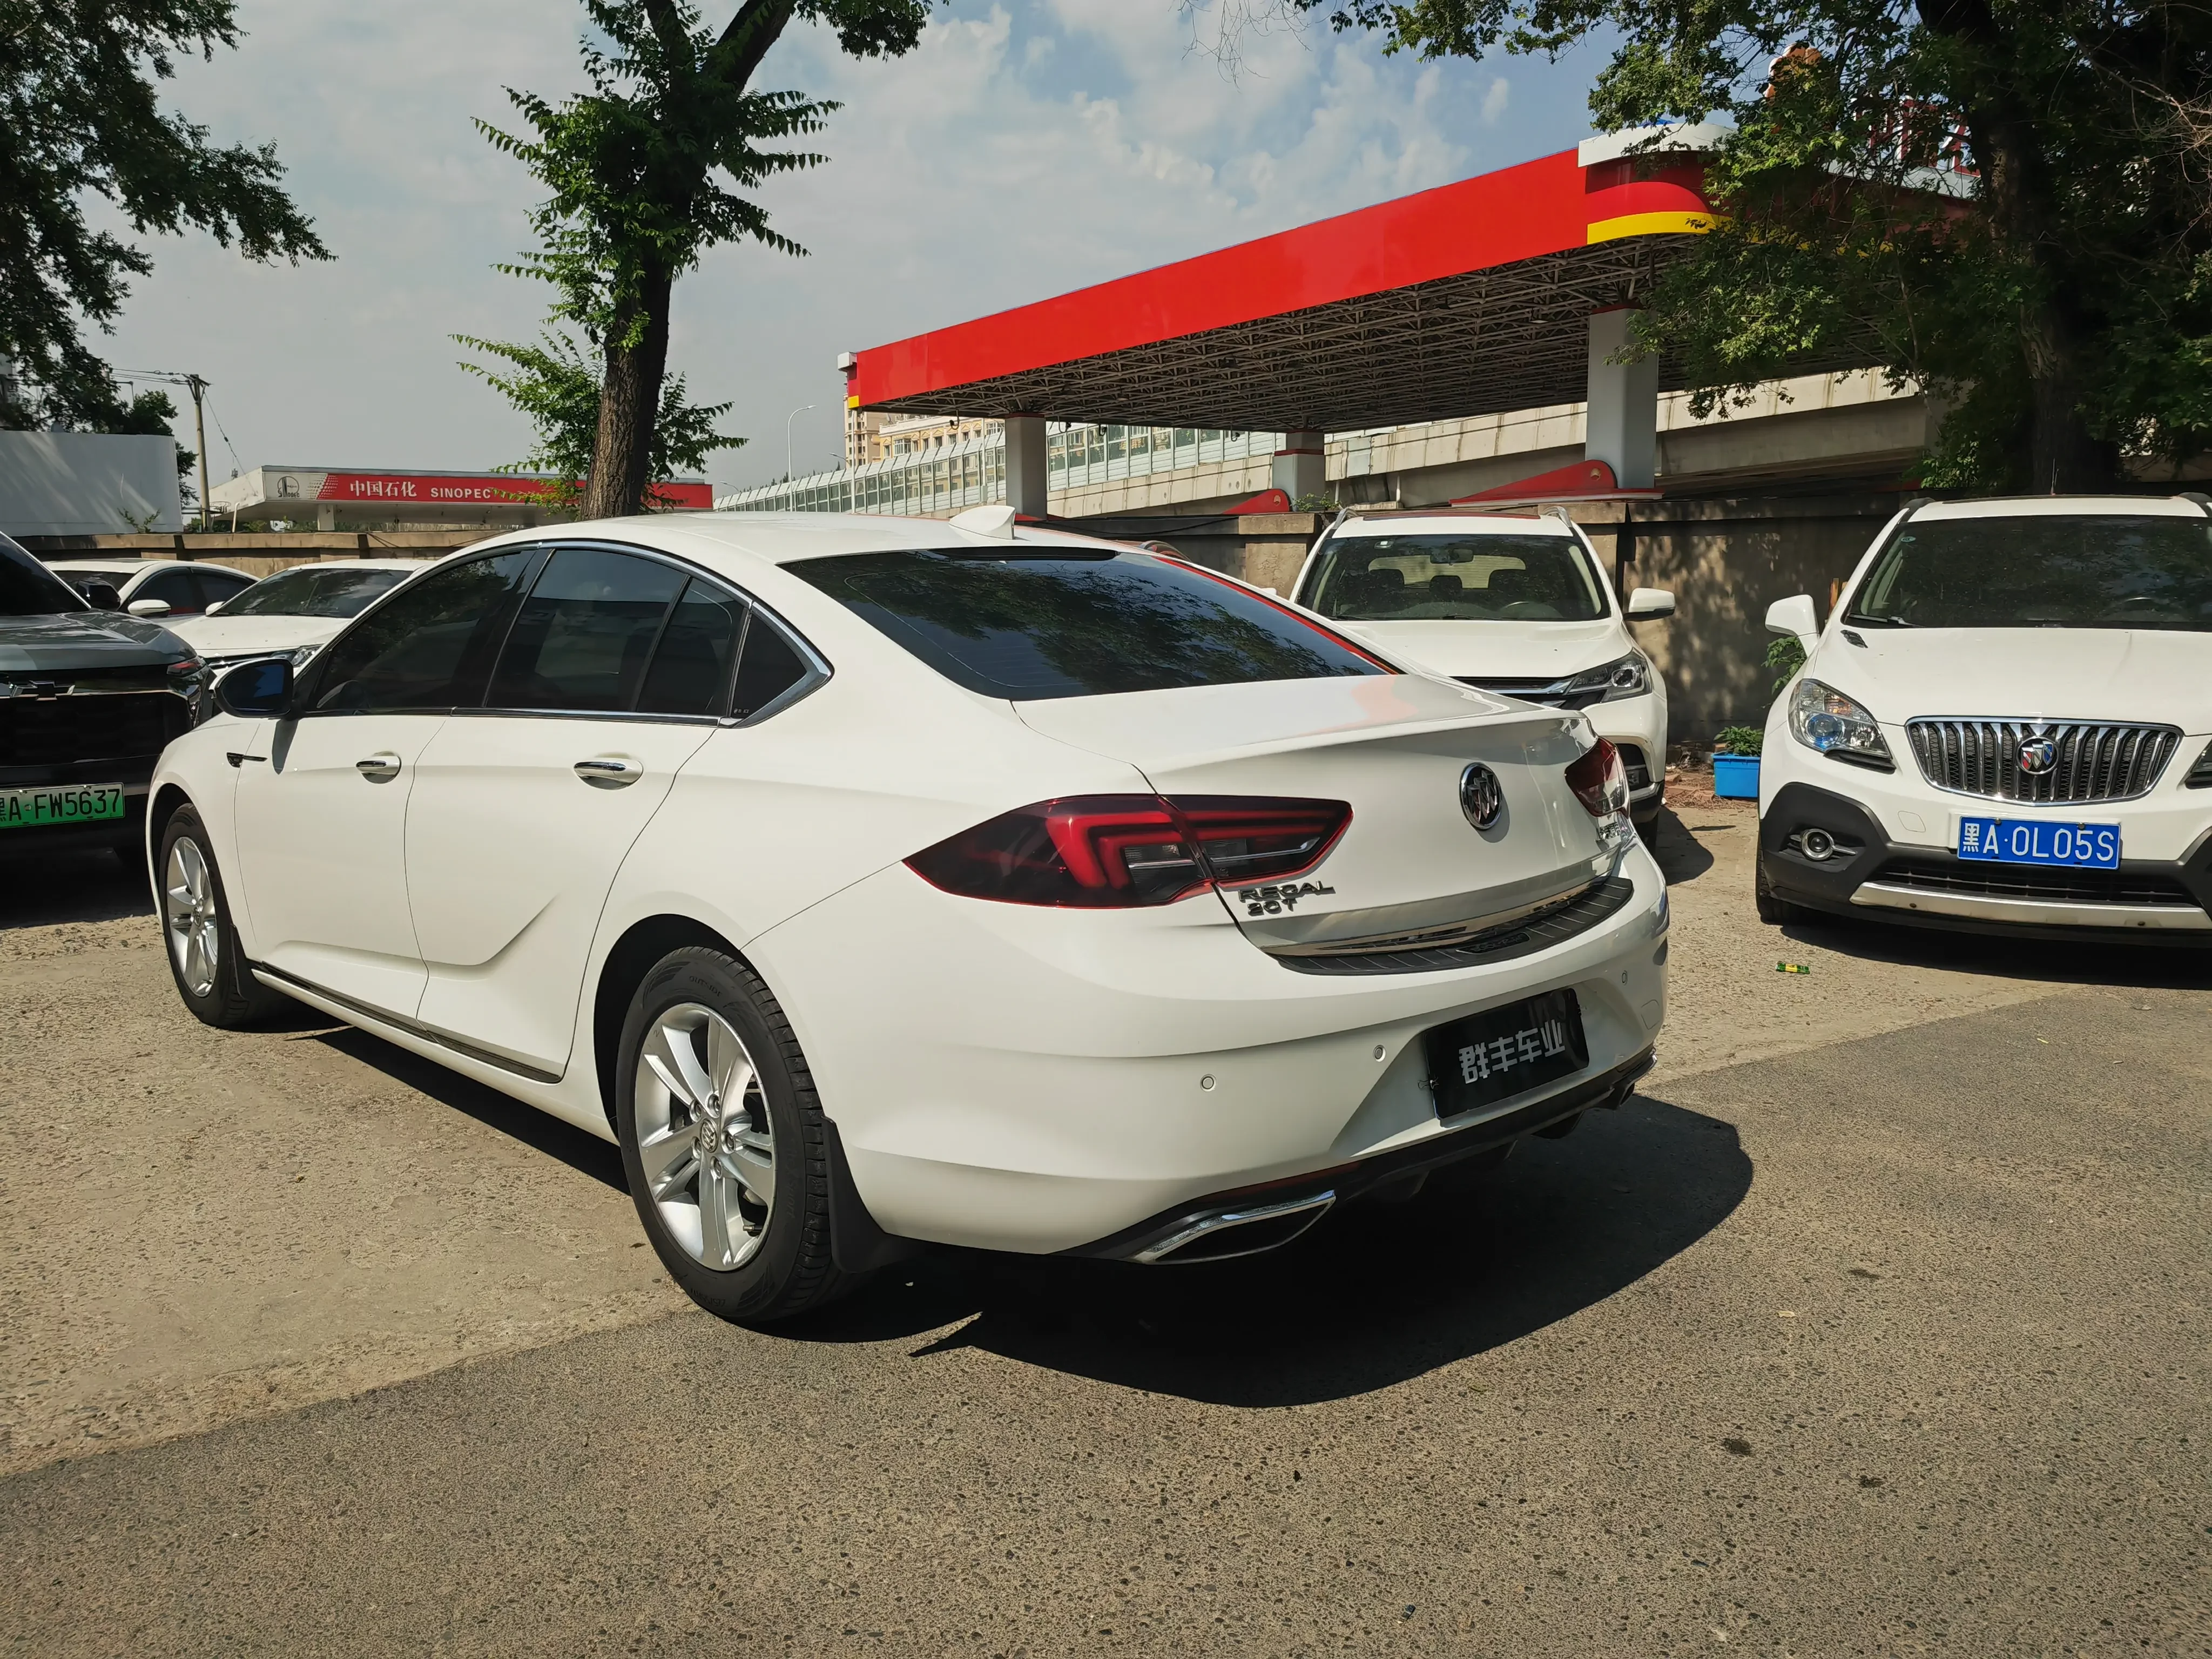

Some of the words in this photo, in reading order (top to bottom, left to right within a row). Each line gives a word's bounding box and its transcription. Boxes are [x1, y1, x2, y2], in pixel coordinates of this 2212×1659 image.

[350, 480, 417, 497] 中国石化
[430, 487, 491, 498] SINOPEC
[1239, 880, 1336, 902] REGAL
[1247, 898, 1298, 916] 20T
[1458, 1019, 1566, 1084] 群丰车业
